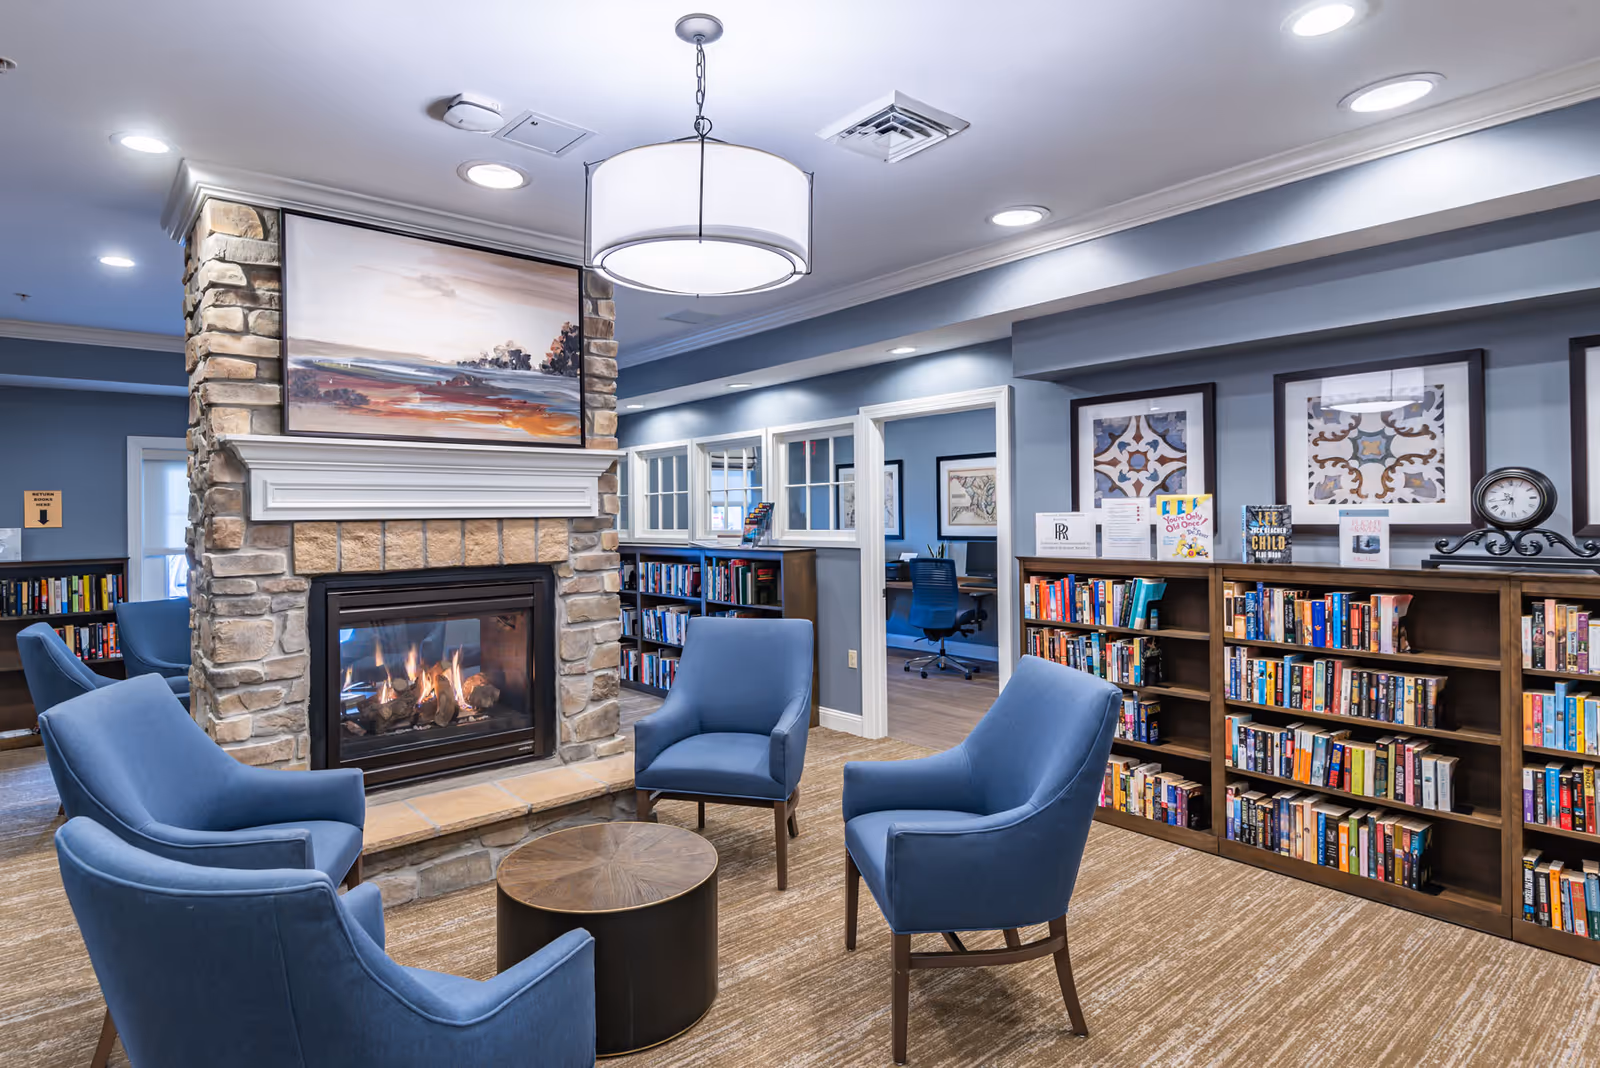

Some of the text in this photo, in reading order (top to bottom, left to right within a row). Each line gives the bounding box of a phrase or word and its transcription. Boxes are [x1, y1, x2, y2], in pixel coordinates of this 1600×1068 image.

[1163, 512, 1203, 525] You're Only
[1258, 511, 1278, 526] LEE
[1166, 522, 1180, 533] Old
[1252, 535, 1286, 550] CHILD
